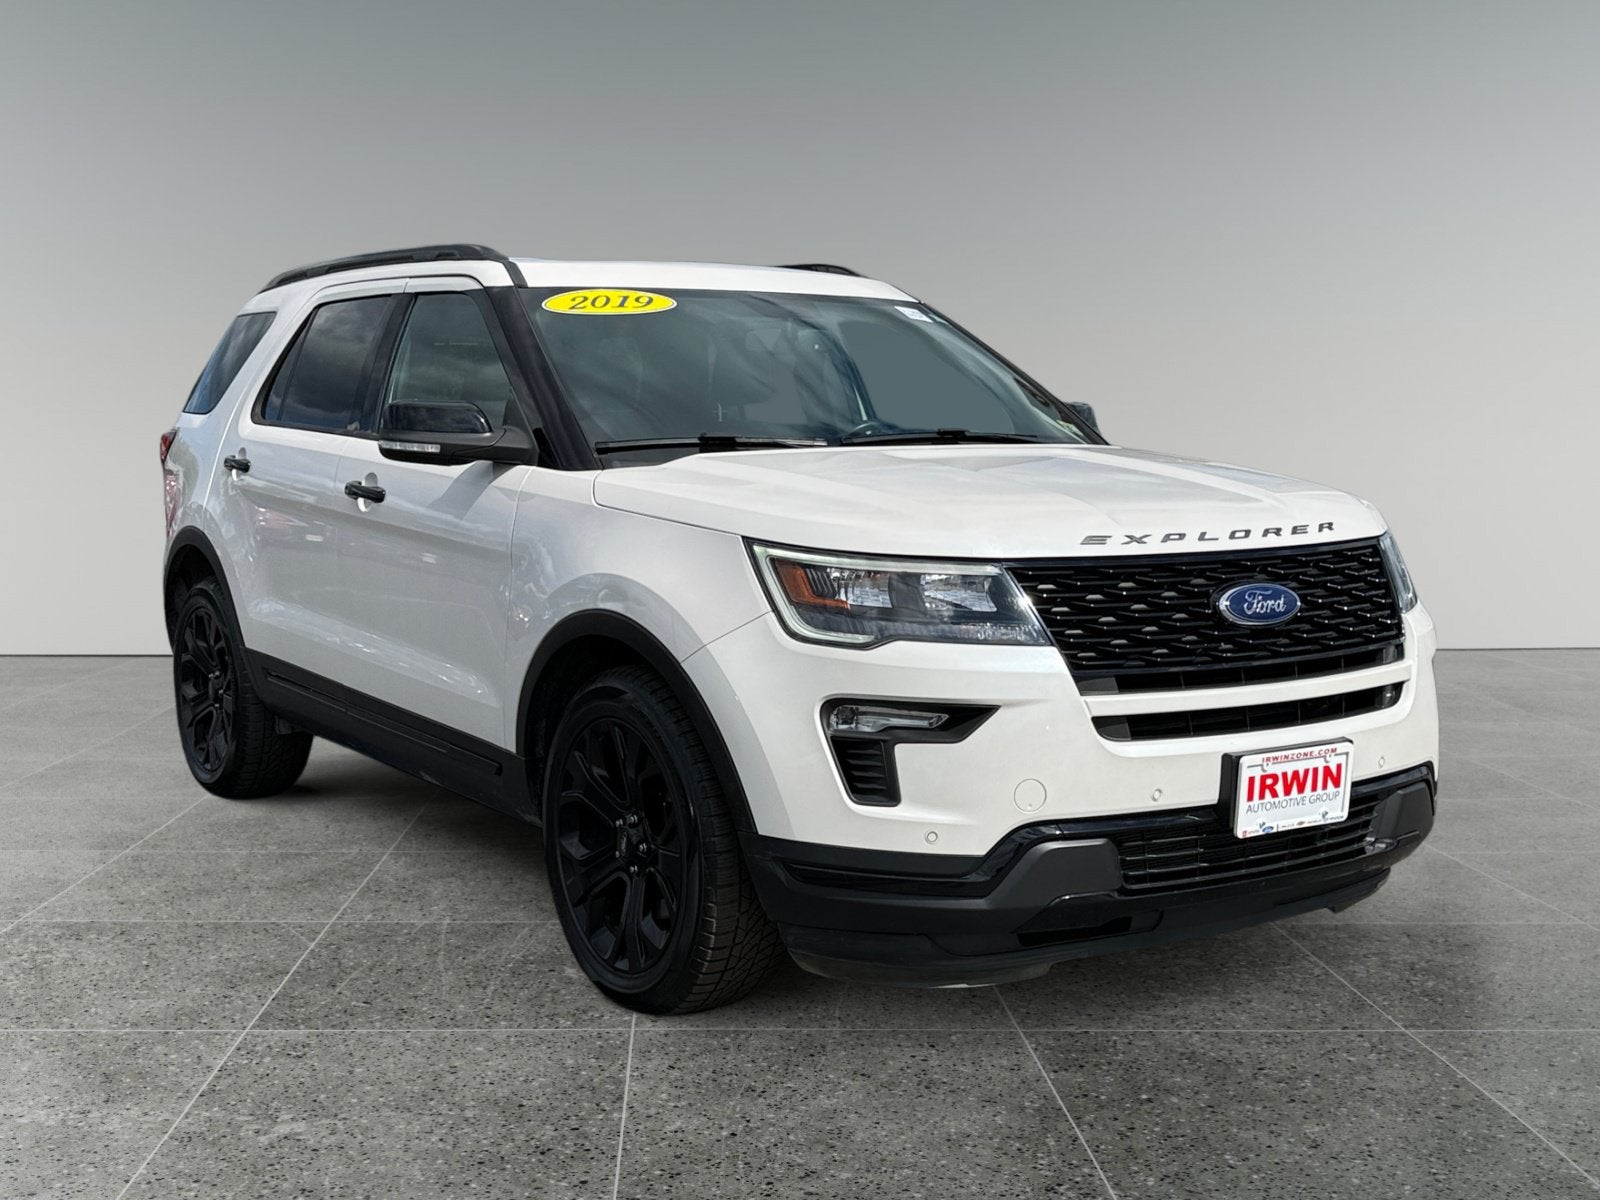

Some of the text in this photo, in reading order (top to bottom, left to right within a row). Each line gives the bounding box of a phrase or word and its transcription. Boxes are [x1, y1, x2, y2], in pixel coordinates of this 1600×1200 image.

[568, 295, 654, 310] 2019
[1080, 522, 1335, 545] EXPLORER
[1243, 590, 1287, 615] Ford
[1262, 748, 1338, 763] IRWINZONE.COM
[1246, 763, 1342, 802] IRWIN
[1246, 790, 1340, 814] AUTOMOTIVE GROUP
